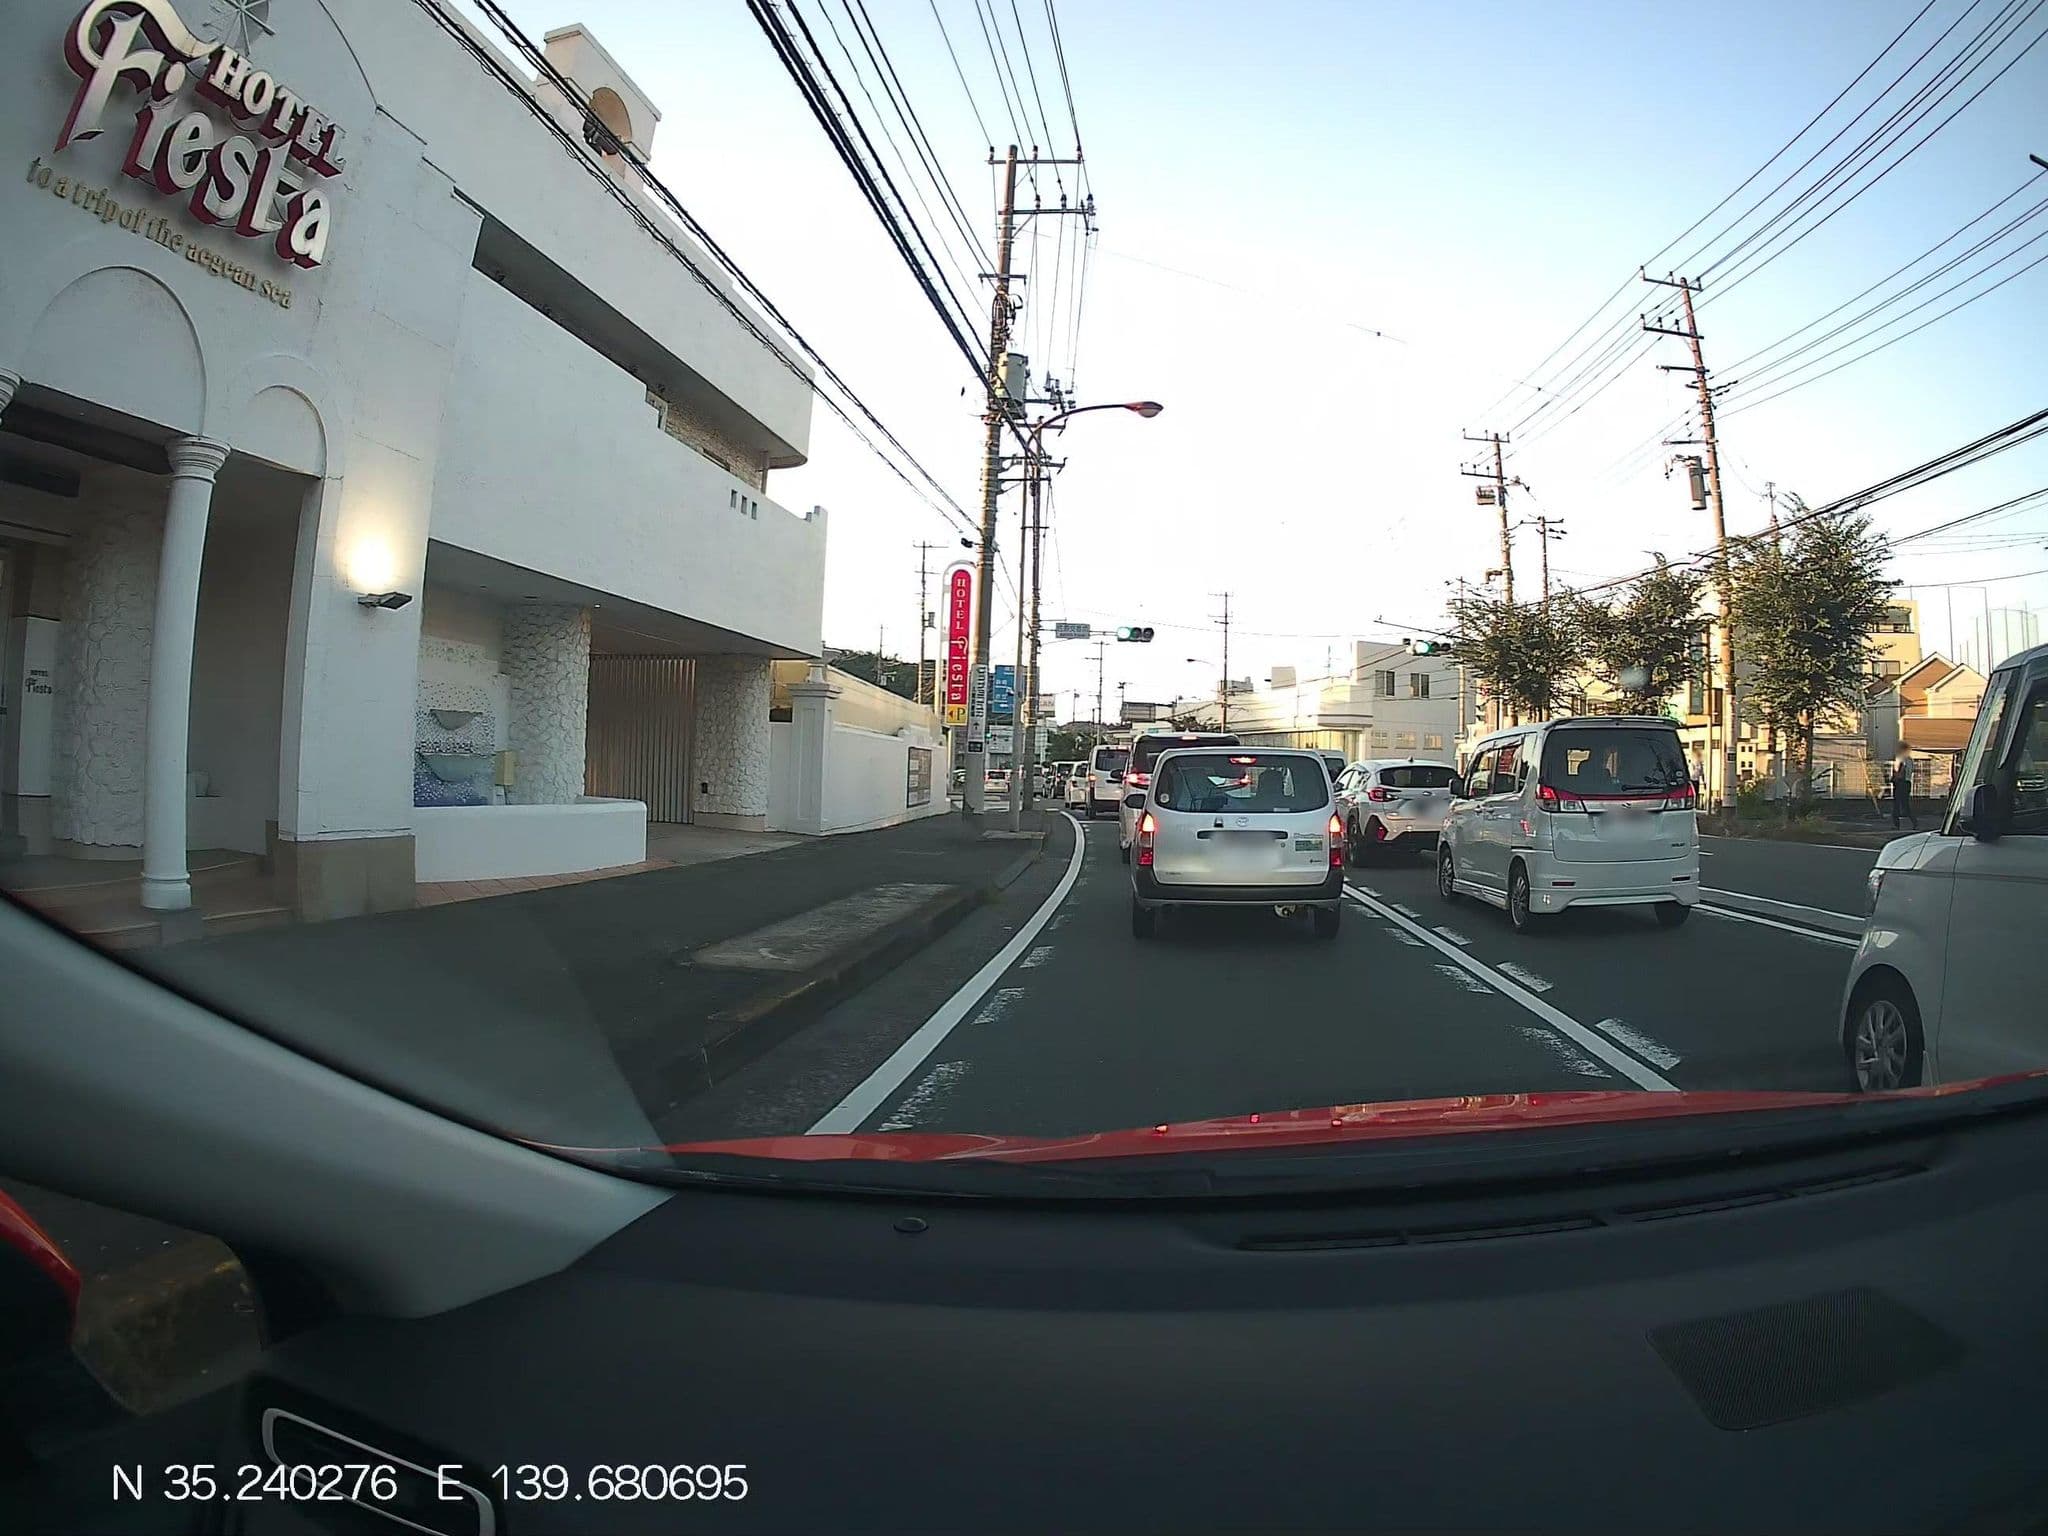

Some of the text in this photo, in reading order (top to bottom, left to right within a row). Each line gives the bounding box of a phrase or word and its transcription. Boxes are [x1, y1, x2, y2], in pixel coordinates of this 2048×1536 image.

[56, 0, 332, 269] Fiesta
[196, 44, 348, 178] HOTEL
[26, 156, 53, 189] to
[53, 175, 70, 199] a
[71, 183, 121, 224] trip
[118, 207, 148, 235] of
[145, 216, 184, 253] the
[185, 243, 257, 292] aegean
[956, 577, 966, 630] HOTEL
[951, 635, 969, 701] Fiesta
[956, 707, 966, 721] P
